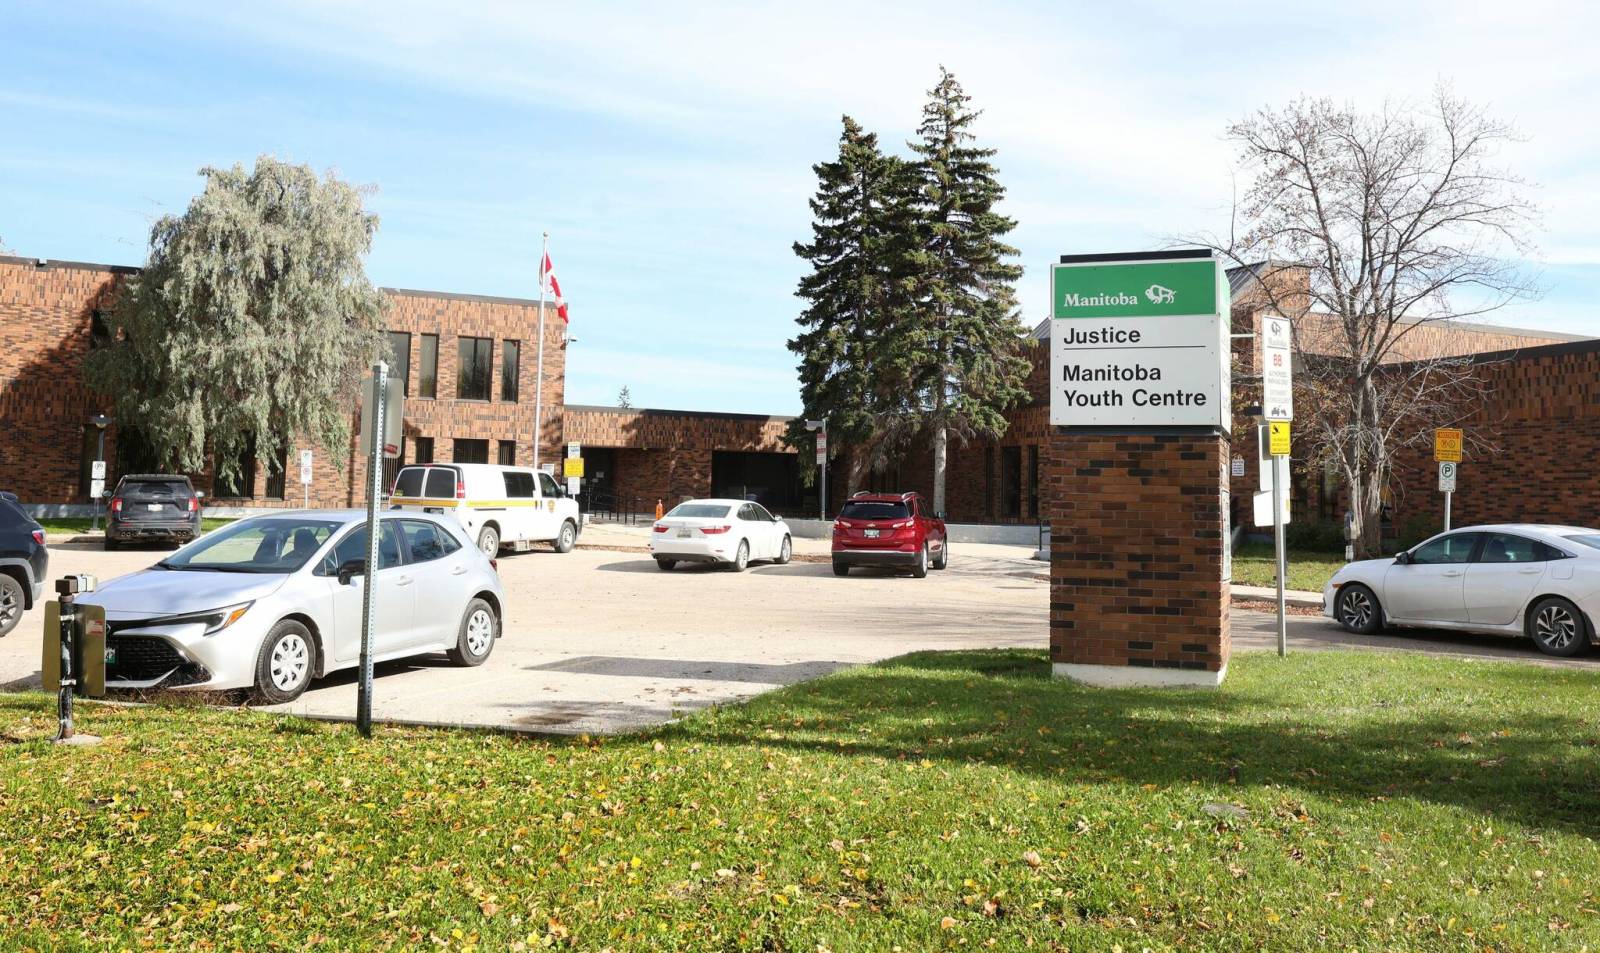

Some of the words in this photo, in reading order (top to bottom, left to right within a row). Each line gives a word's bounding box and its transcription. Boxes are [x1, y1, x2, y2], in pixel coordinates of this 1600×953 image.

[1063, 292, 1138, 307] Manitoba
[1063, 326, 1141, 344] Justice
[1063, 363, 1161, 381] Manitoba
[1064, 389, 1123, 407] Youth
[1132, 388, 1207, 407] Centre
